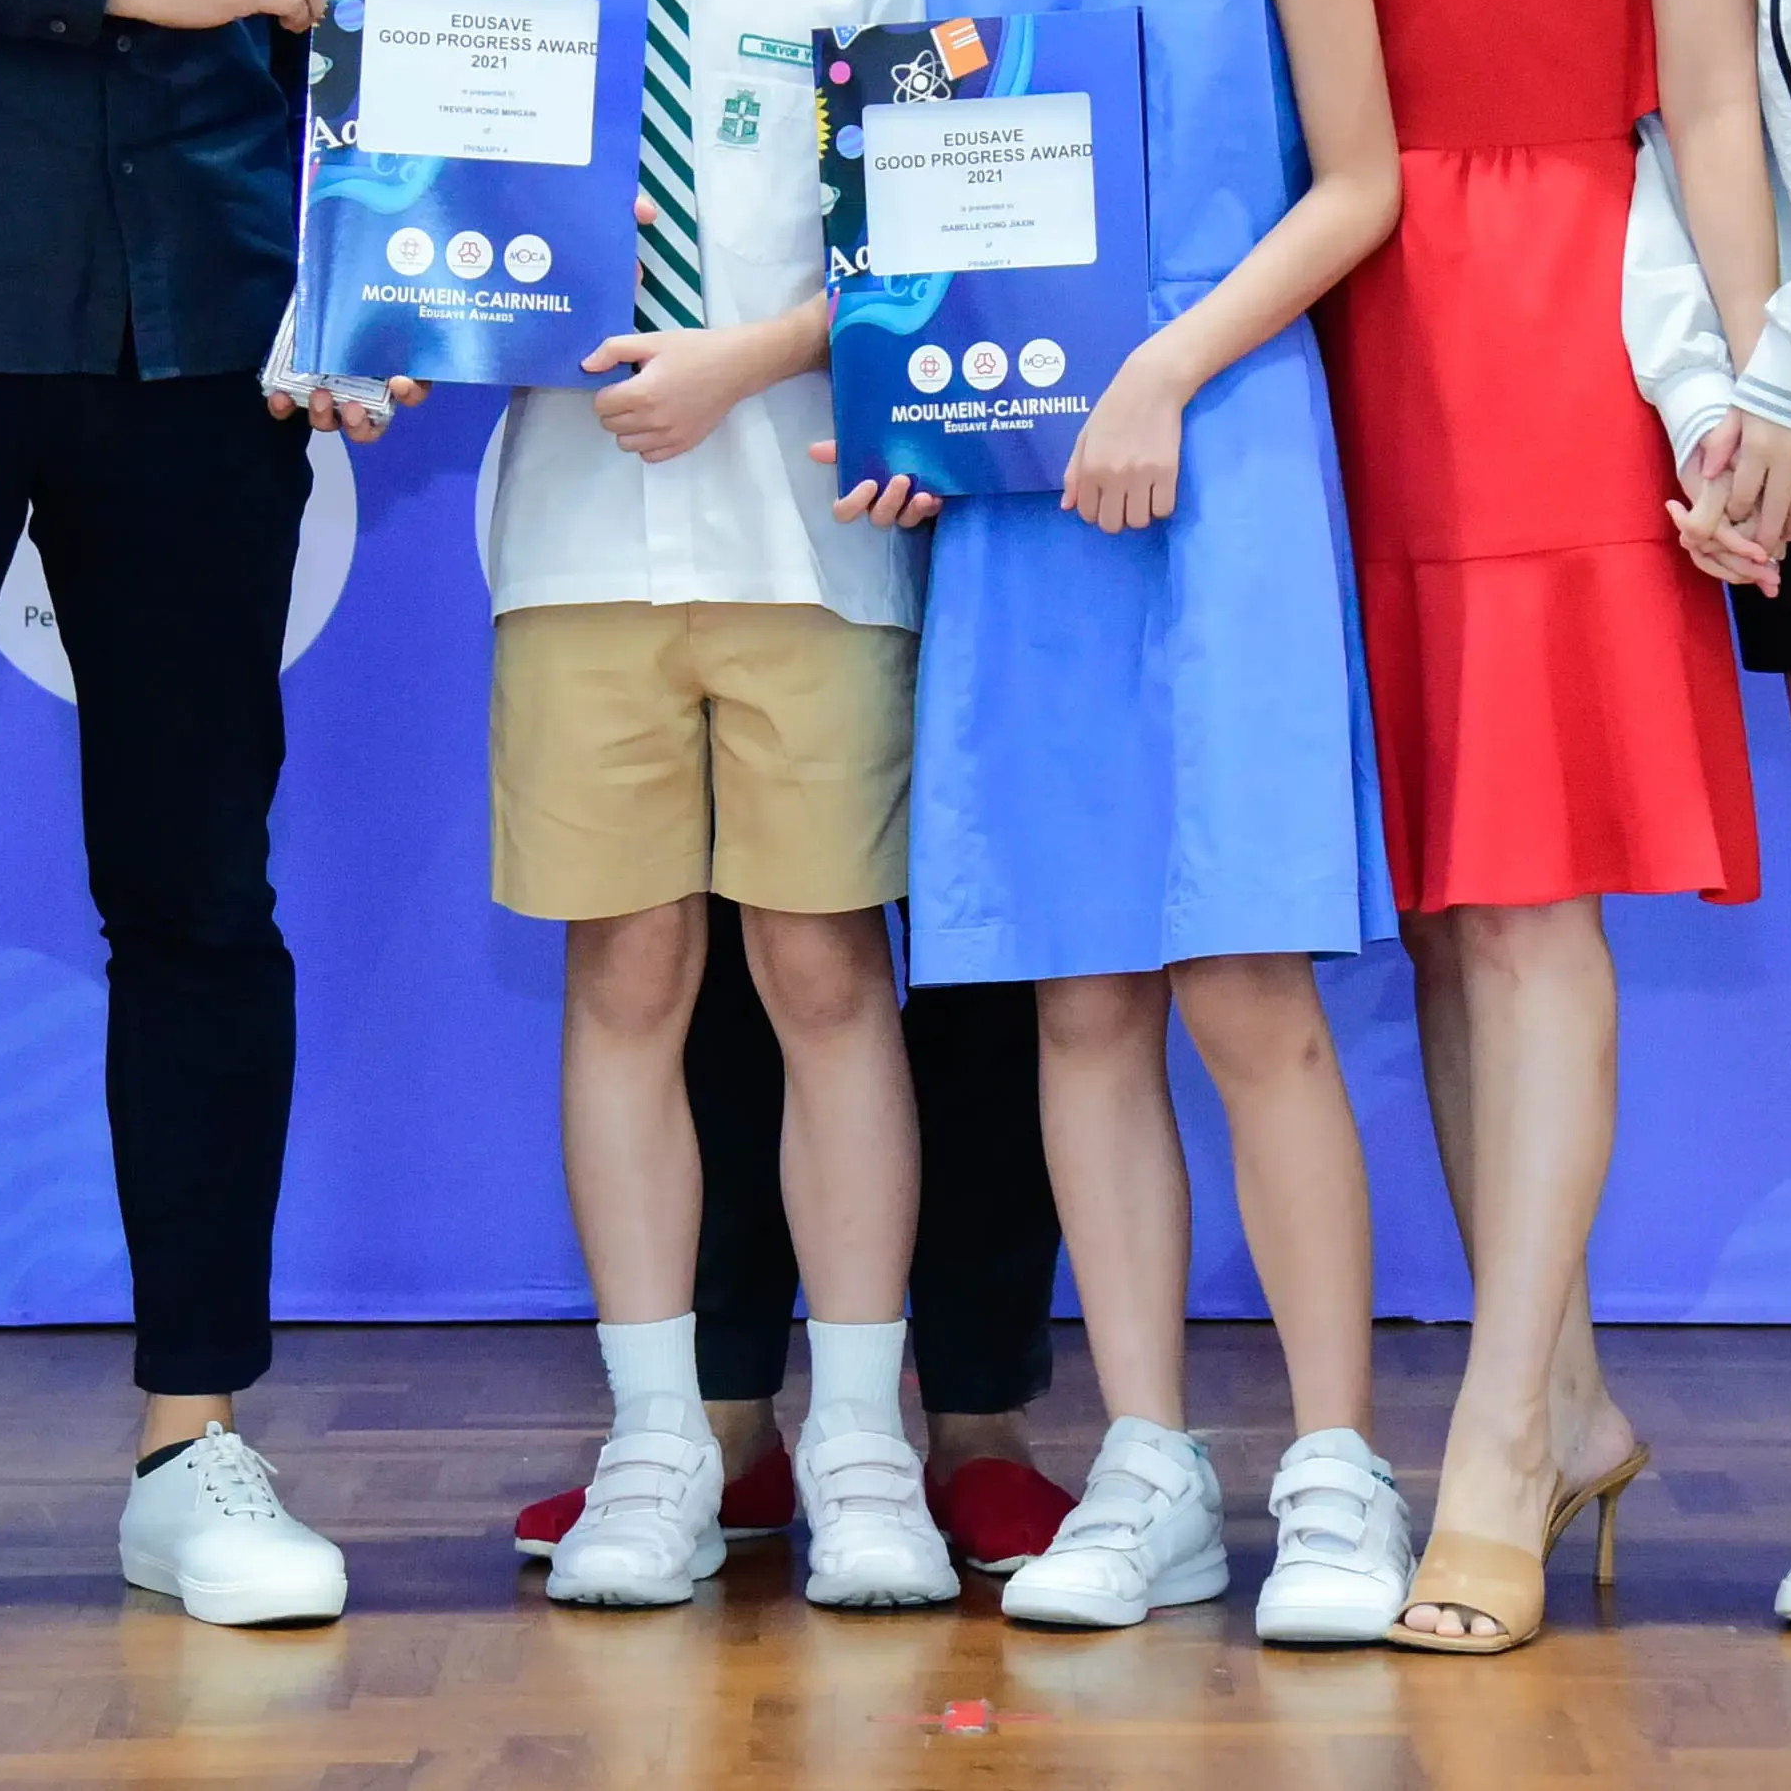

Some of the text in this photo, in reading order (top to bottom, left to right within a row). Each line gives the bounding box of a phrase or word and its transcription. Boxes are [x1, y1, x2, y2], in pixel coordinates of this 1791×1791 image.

[451, 14, 533, 32] EDUSAVE
[379, 30, 431, 46] GOOD
[436, 34, 532, 51] PROGRESS
[761, 42, 799, 58] TREVOR
[471, 55, 508, 70] 2021
[438, 105, 473, 115] TREVOR
[944, 128, 1024, 147] EDUSAVE
[874, 143, 1093, 171] GOOD PROGRESS AWARD
[967, 169, 1003, 184] 2021
[362, 284, 572, 313] MOULMEIN-CAIRNHILL
[469, 308, 514, 323] AWARDS
[891, 396, 1090, 423] MOULMEIN-CAIRNHILL
[991, 418, 1034, 430] AWARDS
